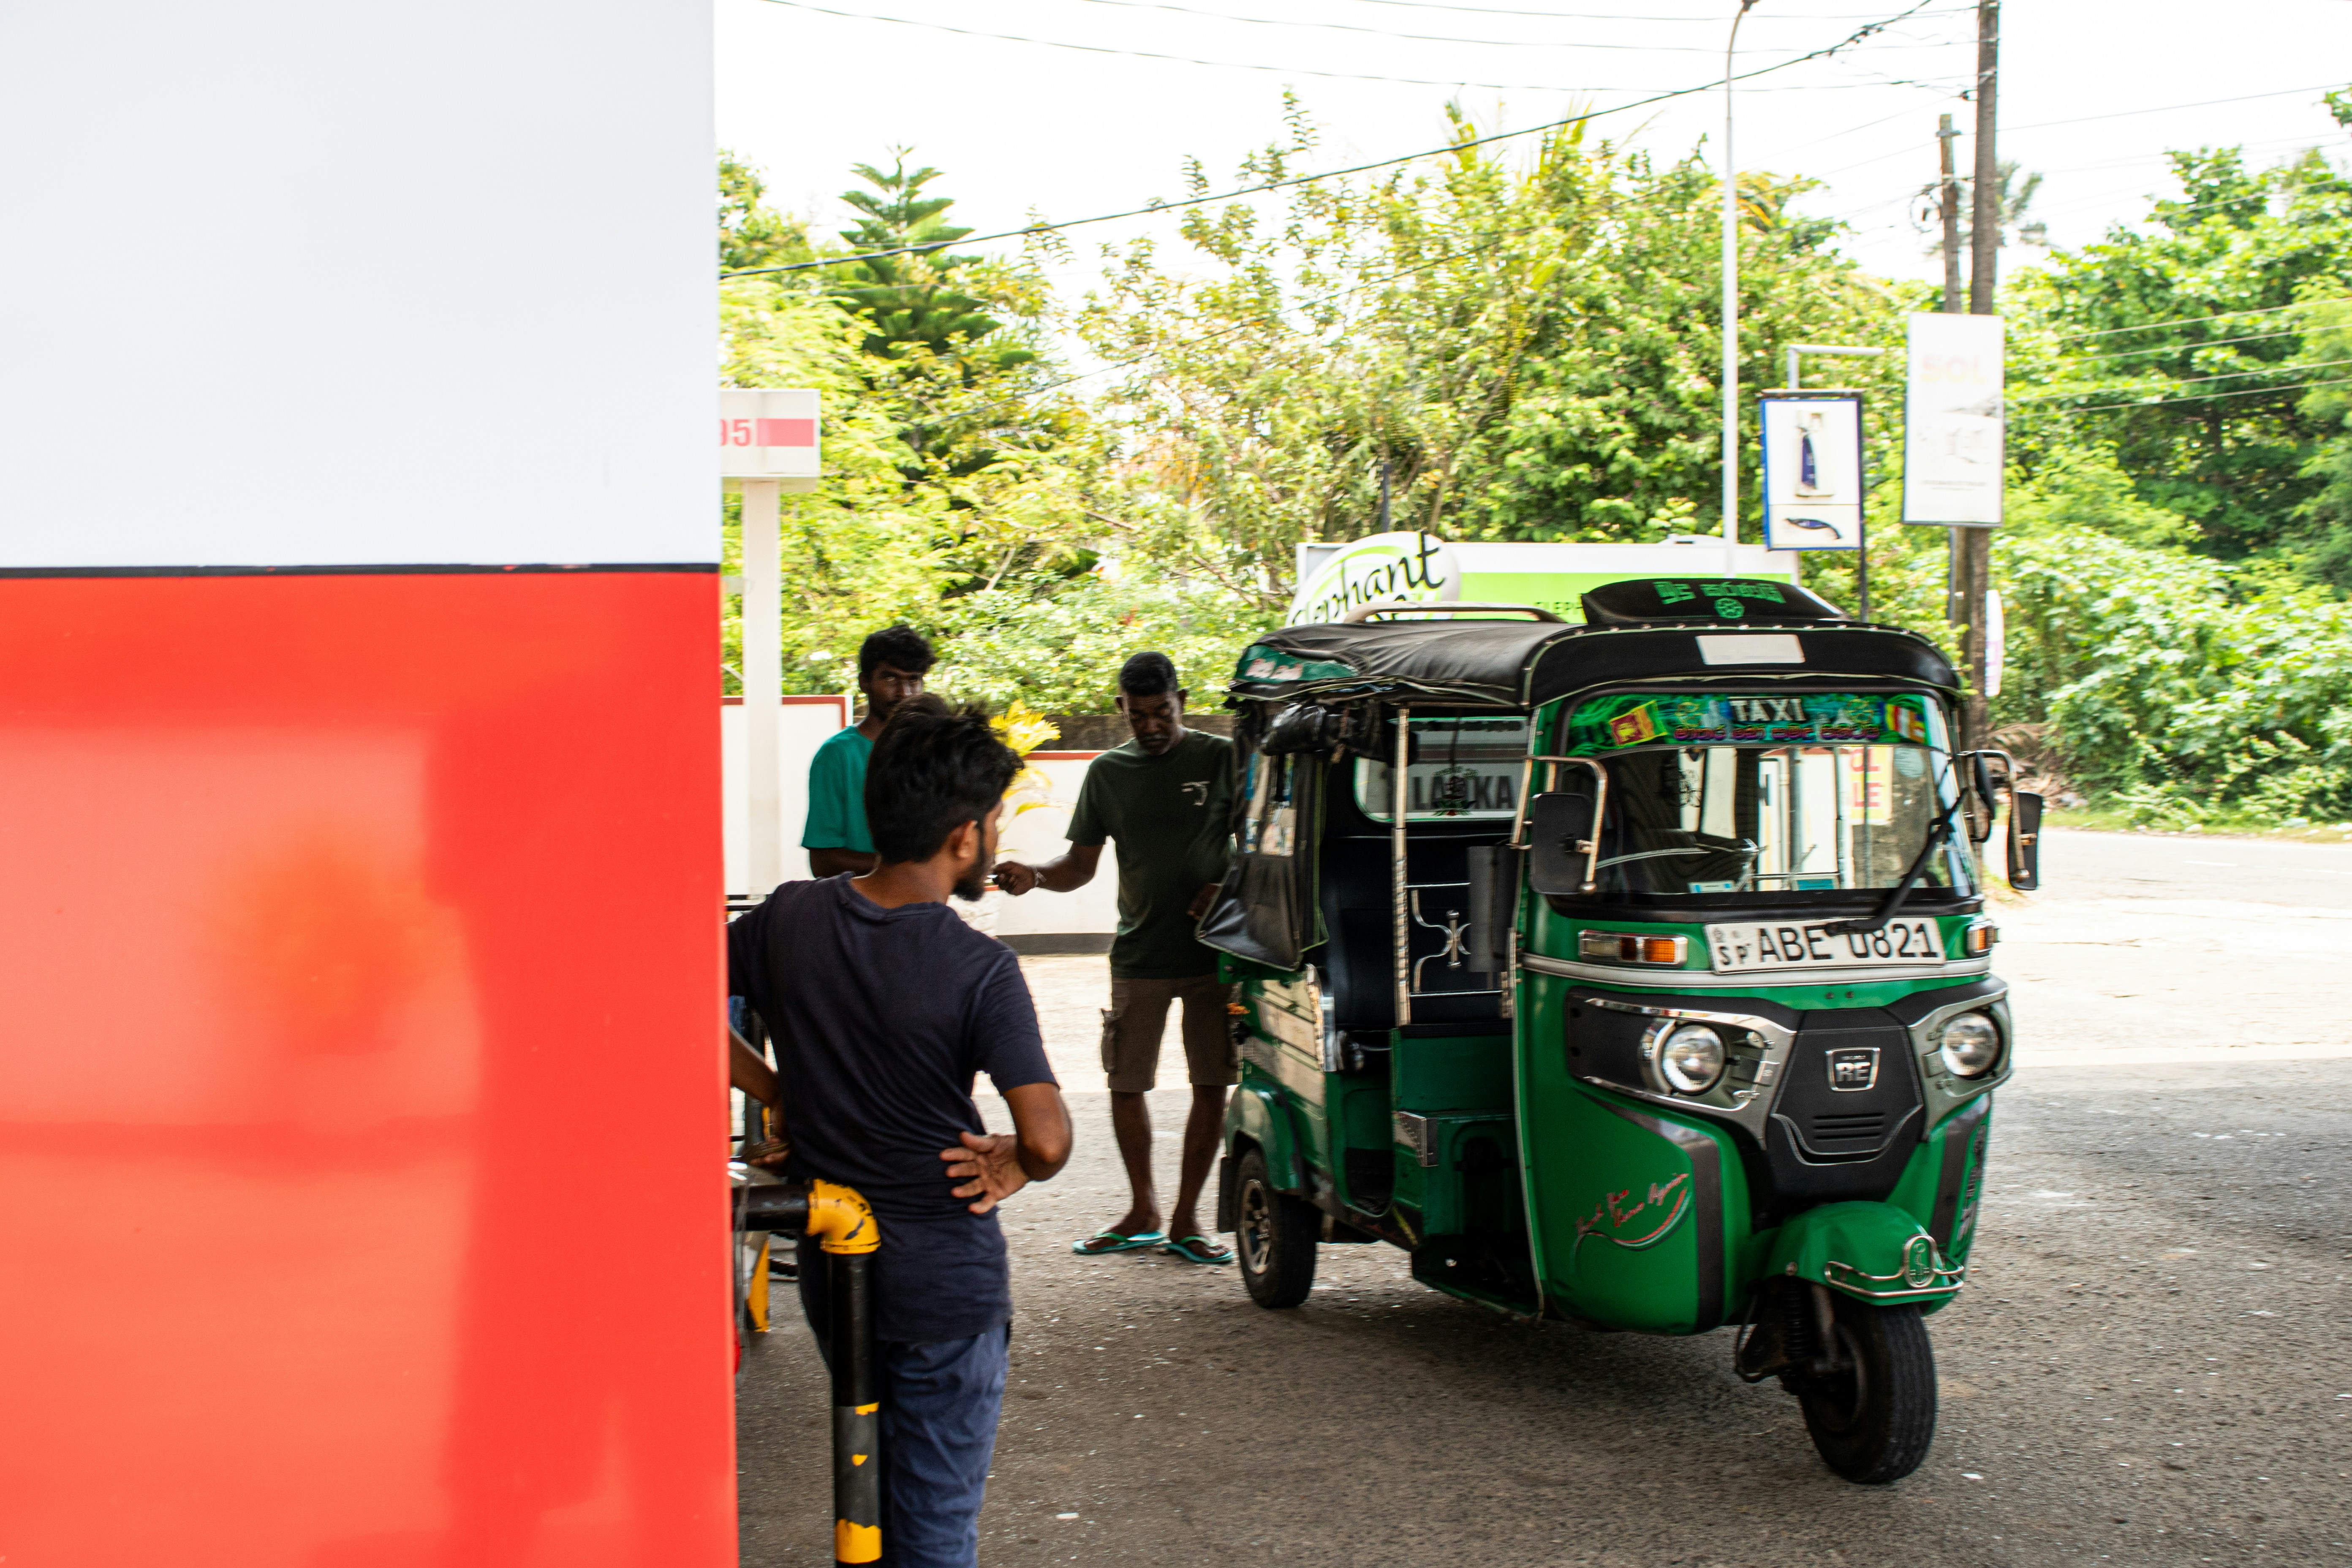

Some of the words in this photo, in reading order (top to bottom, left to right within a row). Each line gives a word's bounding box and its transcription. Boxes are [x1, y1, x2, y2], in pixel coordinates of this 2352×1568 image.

[1730, 699, 1806, 721] TAXI
[1757, 924, 1834, 963] ABE
[1848, 922, 1939, 959] 0821
[1835, 1062, 1871, 1082] RE
